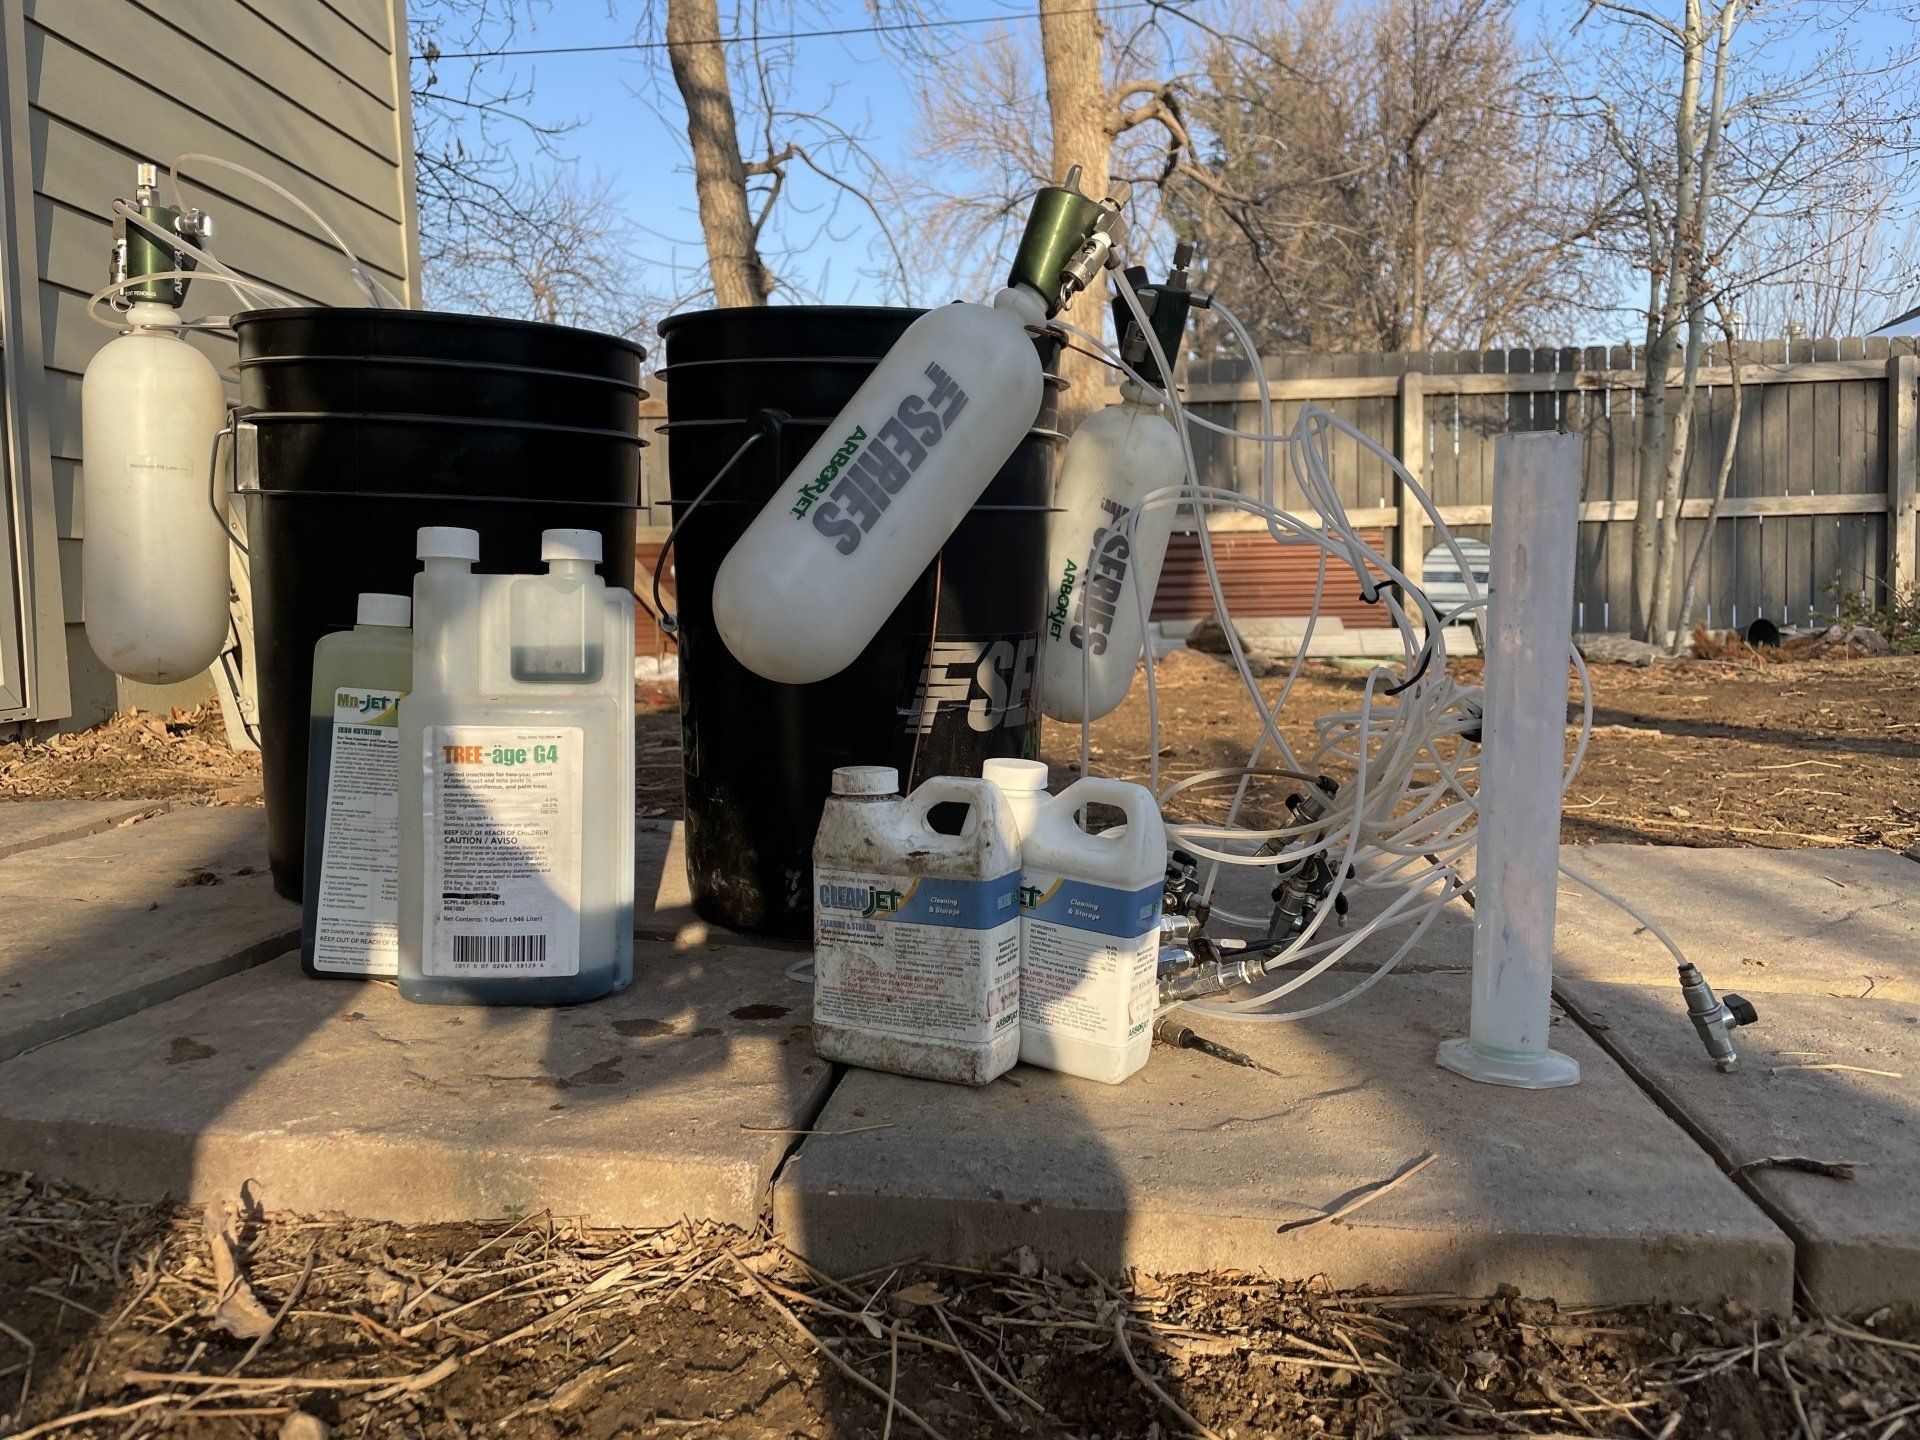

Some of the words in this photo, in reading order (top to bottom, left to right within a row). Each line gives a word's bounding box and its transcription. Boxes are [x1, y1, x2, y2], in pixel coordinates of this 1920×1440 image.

[534, 745, 558, 763] G4
[930, 896, 958, 906] Cleaning
[1070, 898, 1099, 911] Cleaning
[935, 906, 961, 916] Storage
[1074, 908, 1101, 920] Storage
[1030, 970, 1044, 978] LABEL
[1046, 974, 1065, 983] BEFORE
[1045, 980, 1070, 990] CHILDREN
